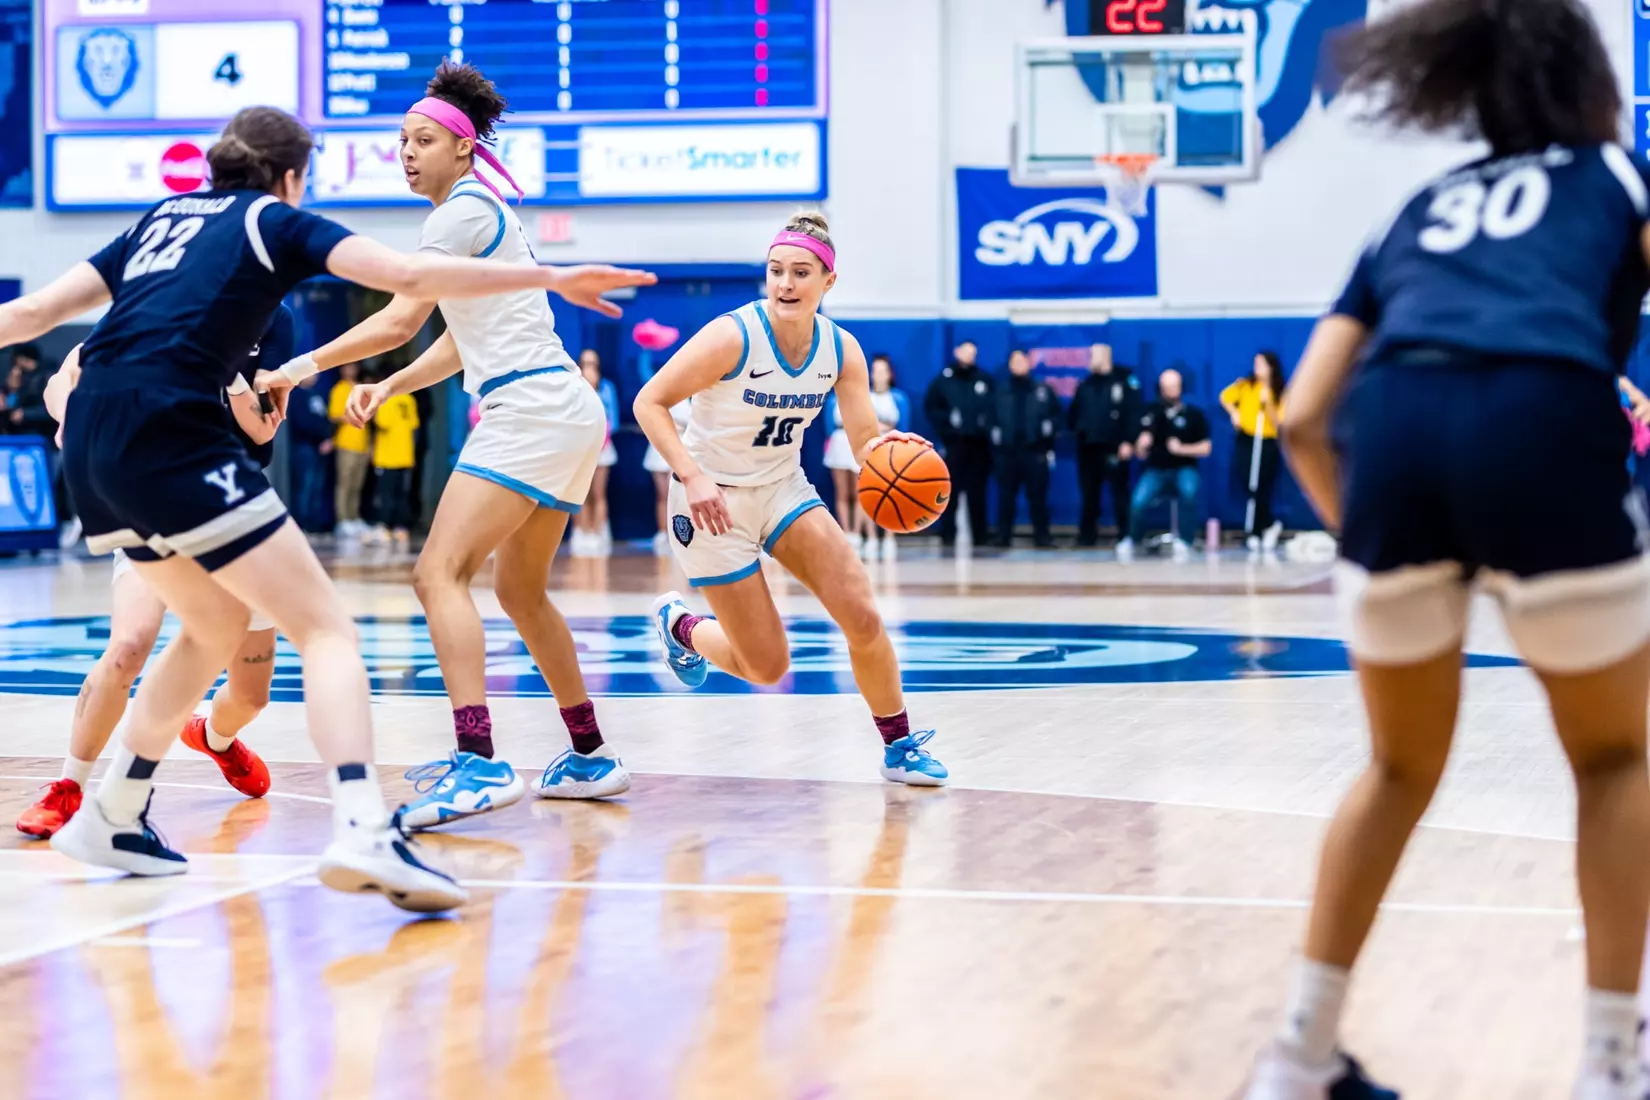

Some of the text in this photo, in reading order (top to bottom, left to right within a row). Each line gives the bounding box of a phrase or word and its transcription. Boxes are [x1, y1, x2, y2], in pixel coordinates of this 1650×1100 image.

[1104, 0, 1169, 34] 22
[213, 53, 243, 85] 4
[1416, 165, 1552, 253] 30
[122, 215, 205, 282] 22
[974, 214, 1119, 266] SNY
[743, 388, 824, 409] COLUMBI
[751, 415, 805, 447] 10
[203, 461, 246, 506] Y
